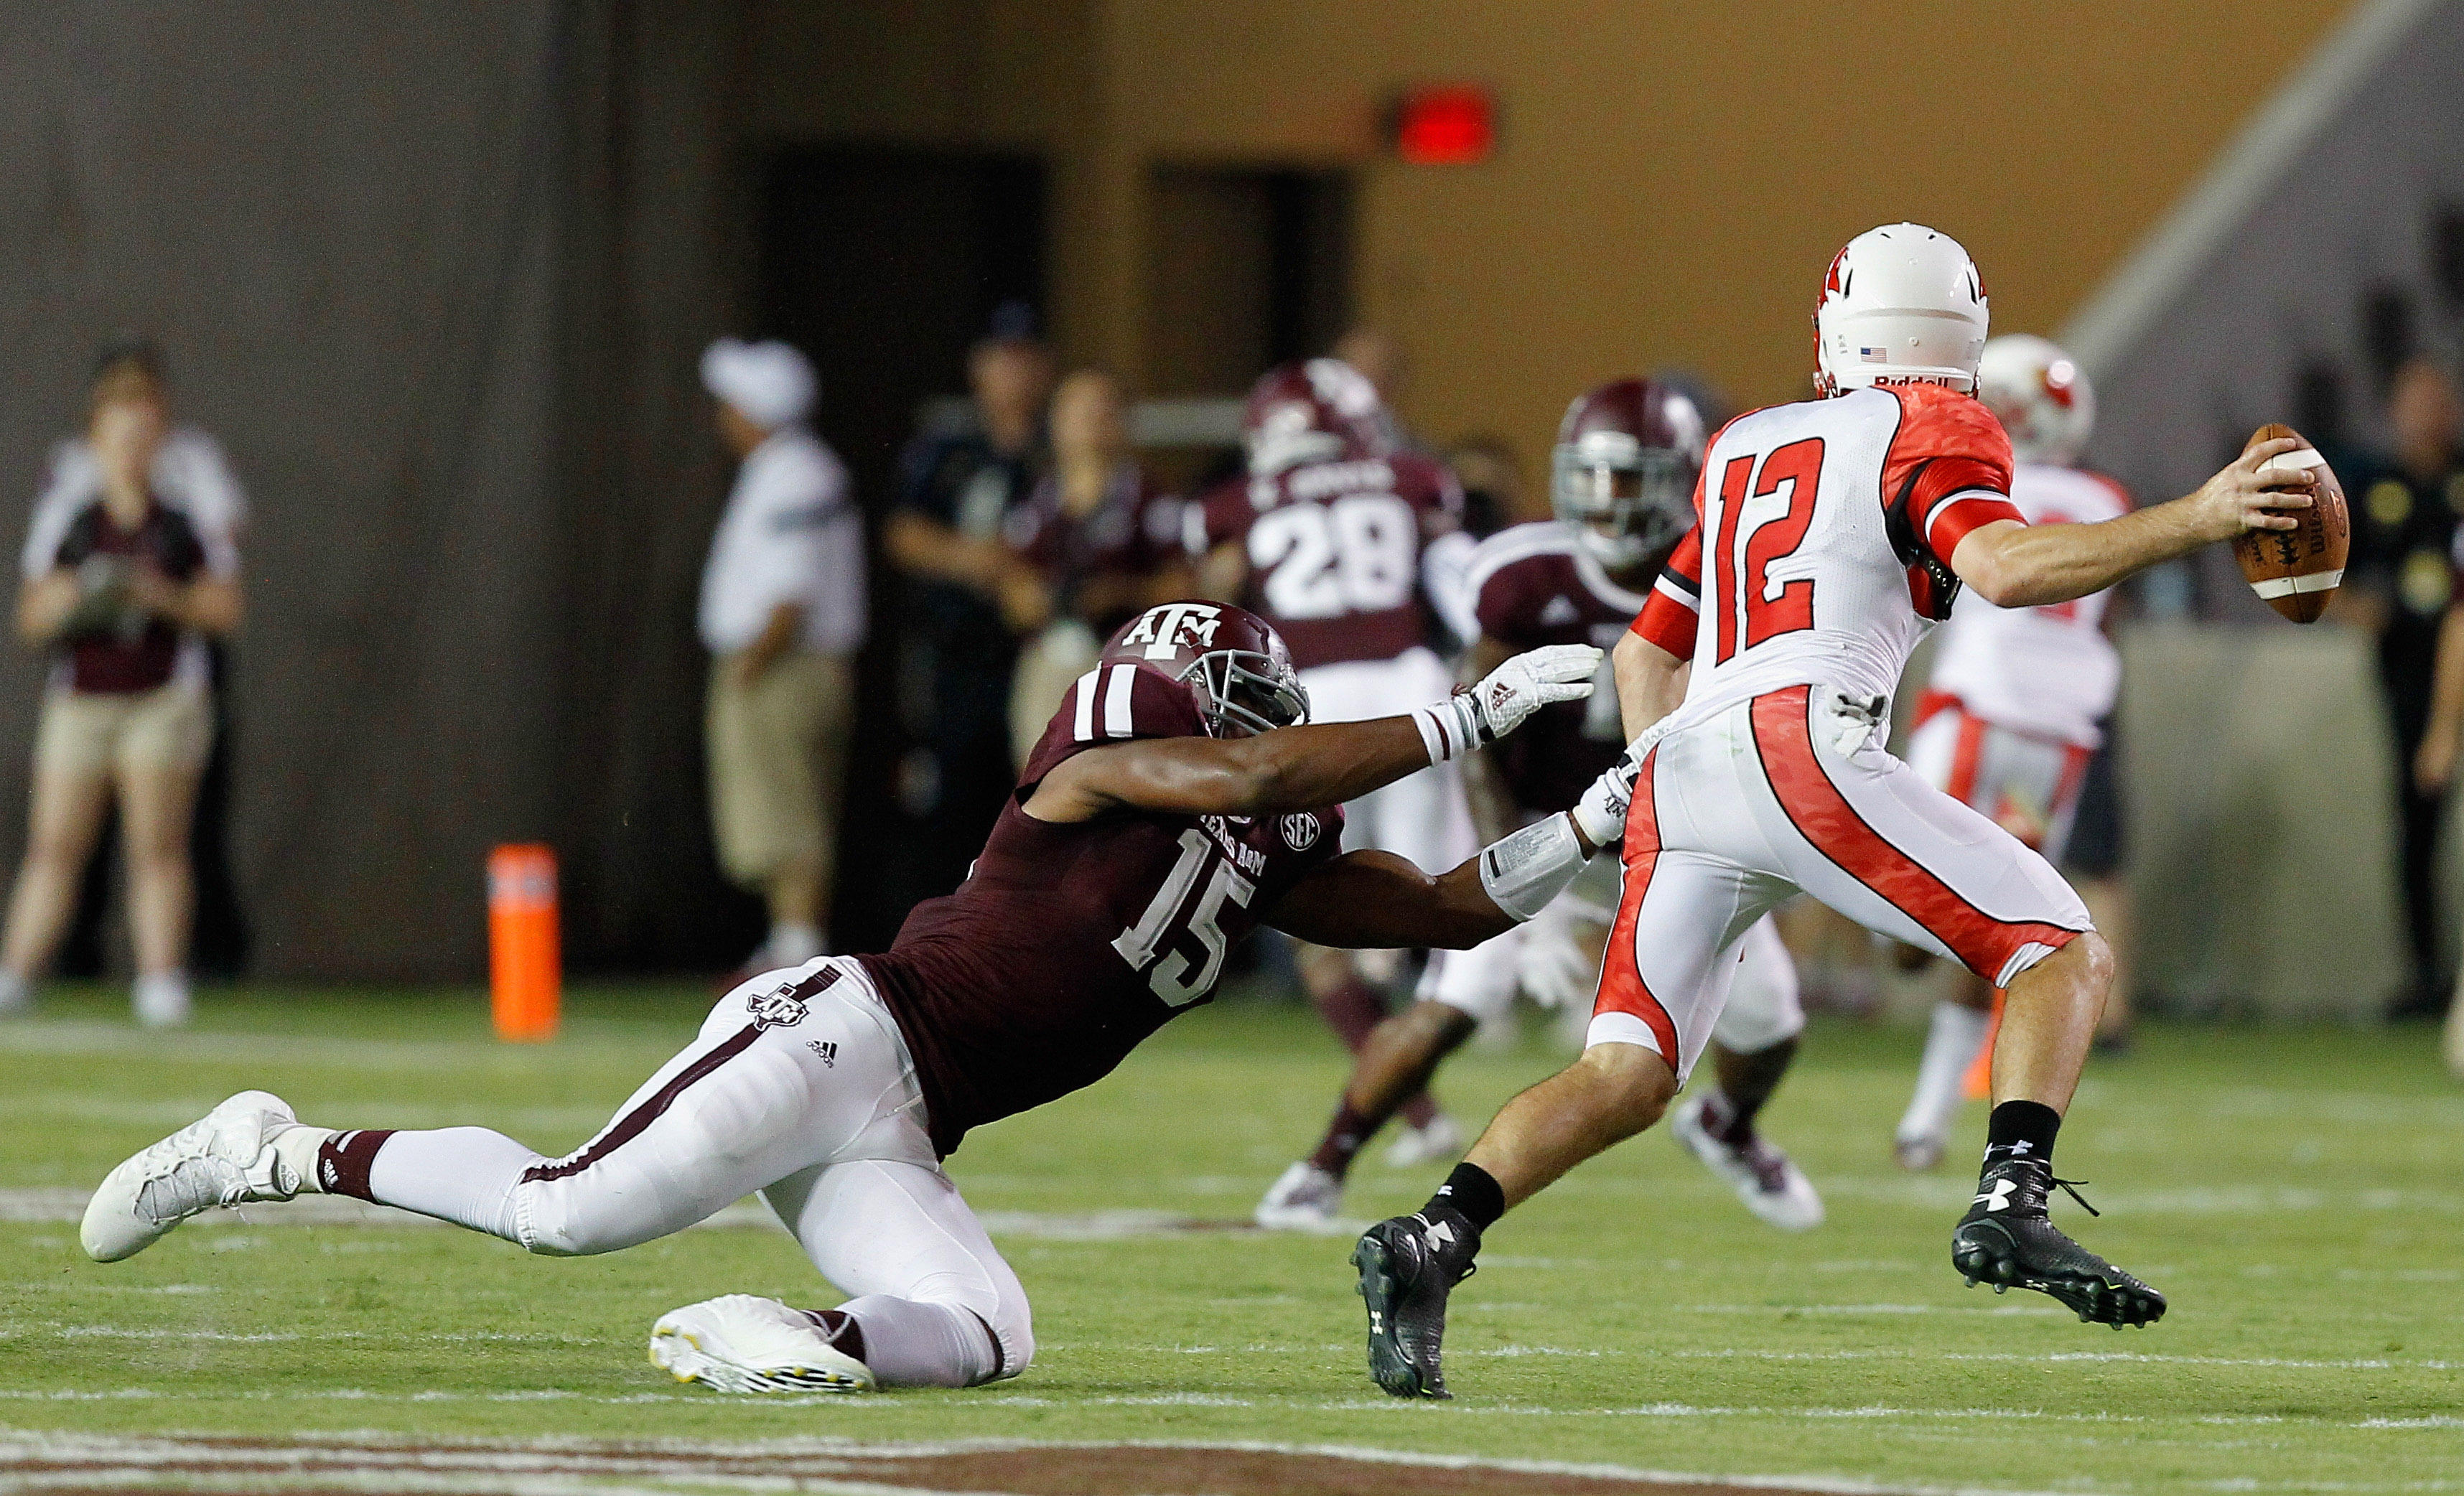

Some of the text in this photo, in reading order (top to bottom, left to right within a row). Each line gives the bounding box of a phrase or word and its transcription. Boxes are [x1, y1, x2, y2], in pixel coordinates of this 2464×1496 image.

[1246, 494, 1417, 620] 28
[1715, 436, 1824, 668] 12
[1284, 813, 1315, 848] SEC
[1111, 828, 1256, 1007] 15
[806, 1041, 834, 1068] adidas
